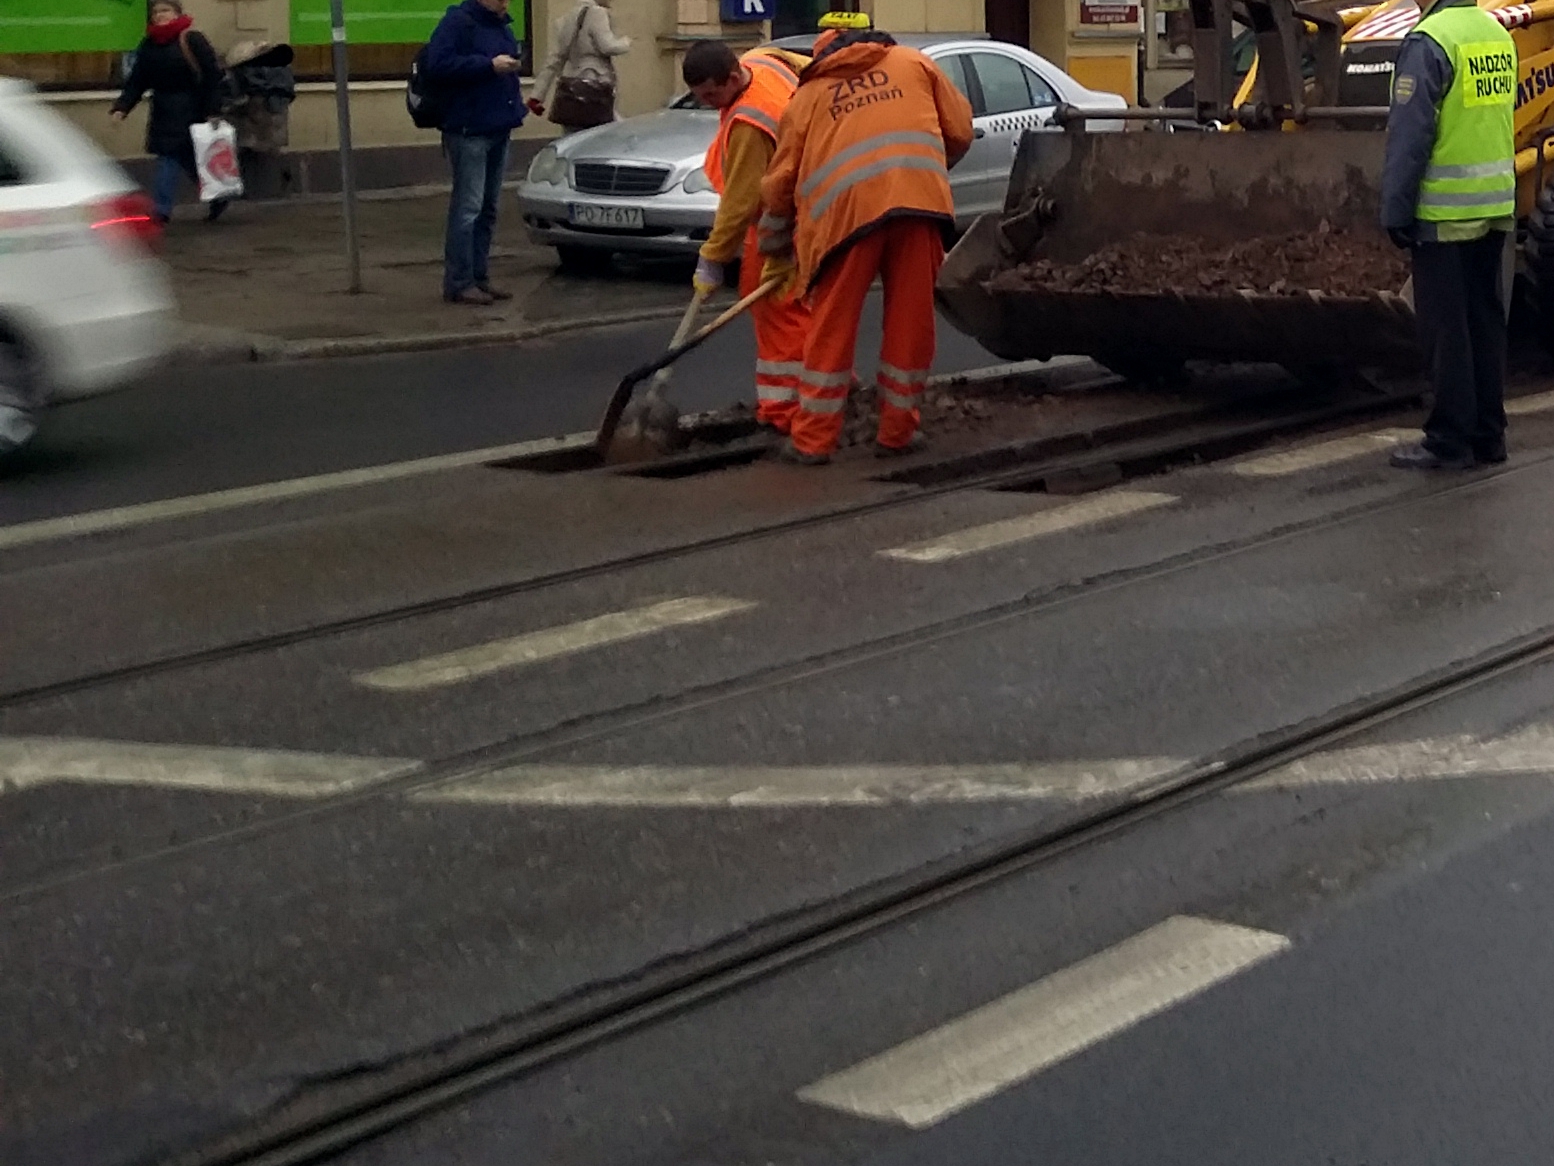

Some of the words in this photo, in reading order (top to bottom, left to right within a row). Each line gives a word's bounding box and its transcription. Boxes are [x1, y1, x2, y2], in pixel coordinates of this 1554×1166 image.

[1468, 51, 1513, 76] NADZÓR
[828, 69, 889, 103] ZRD
[1476, 75, 1512, 98] RUCHU
[829, 85, 904, 122] Poznań
